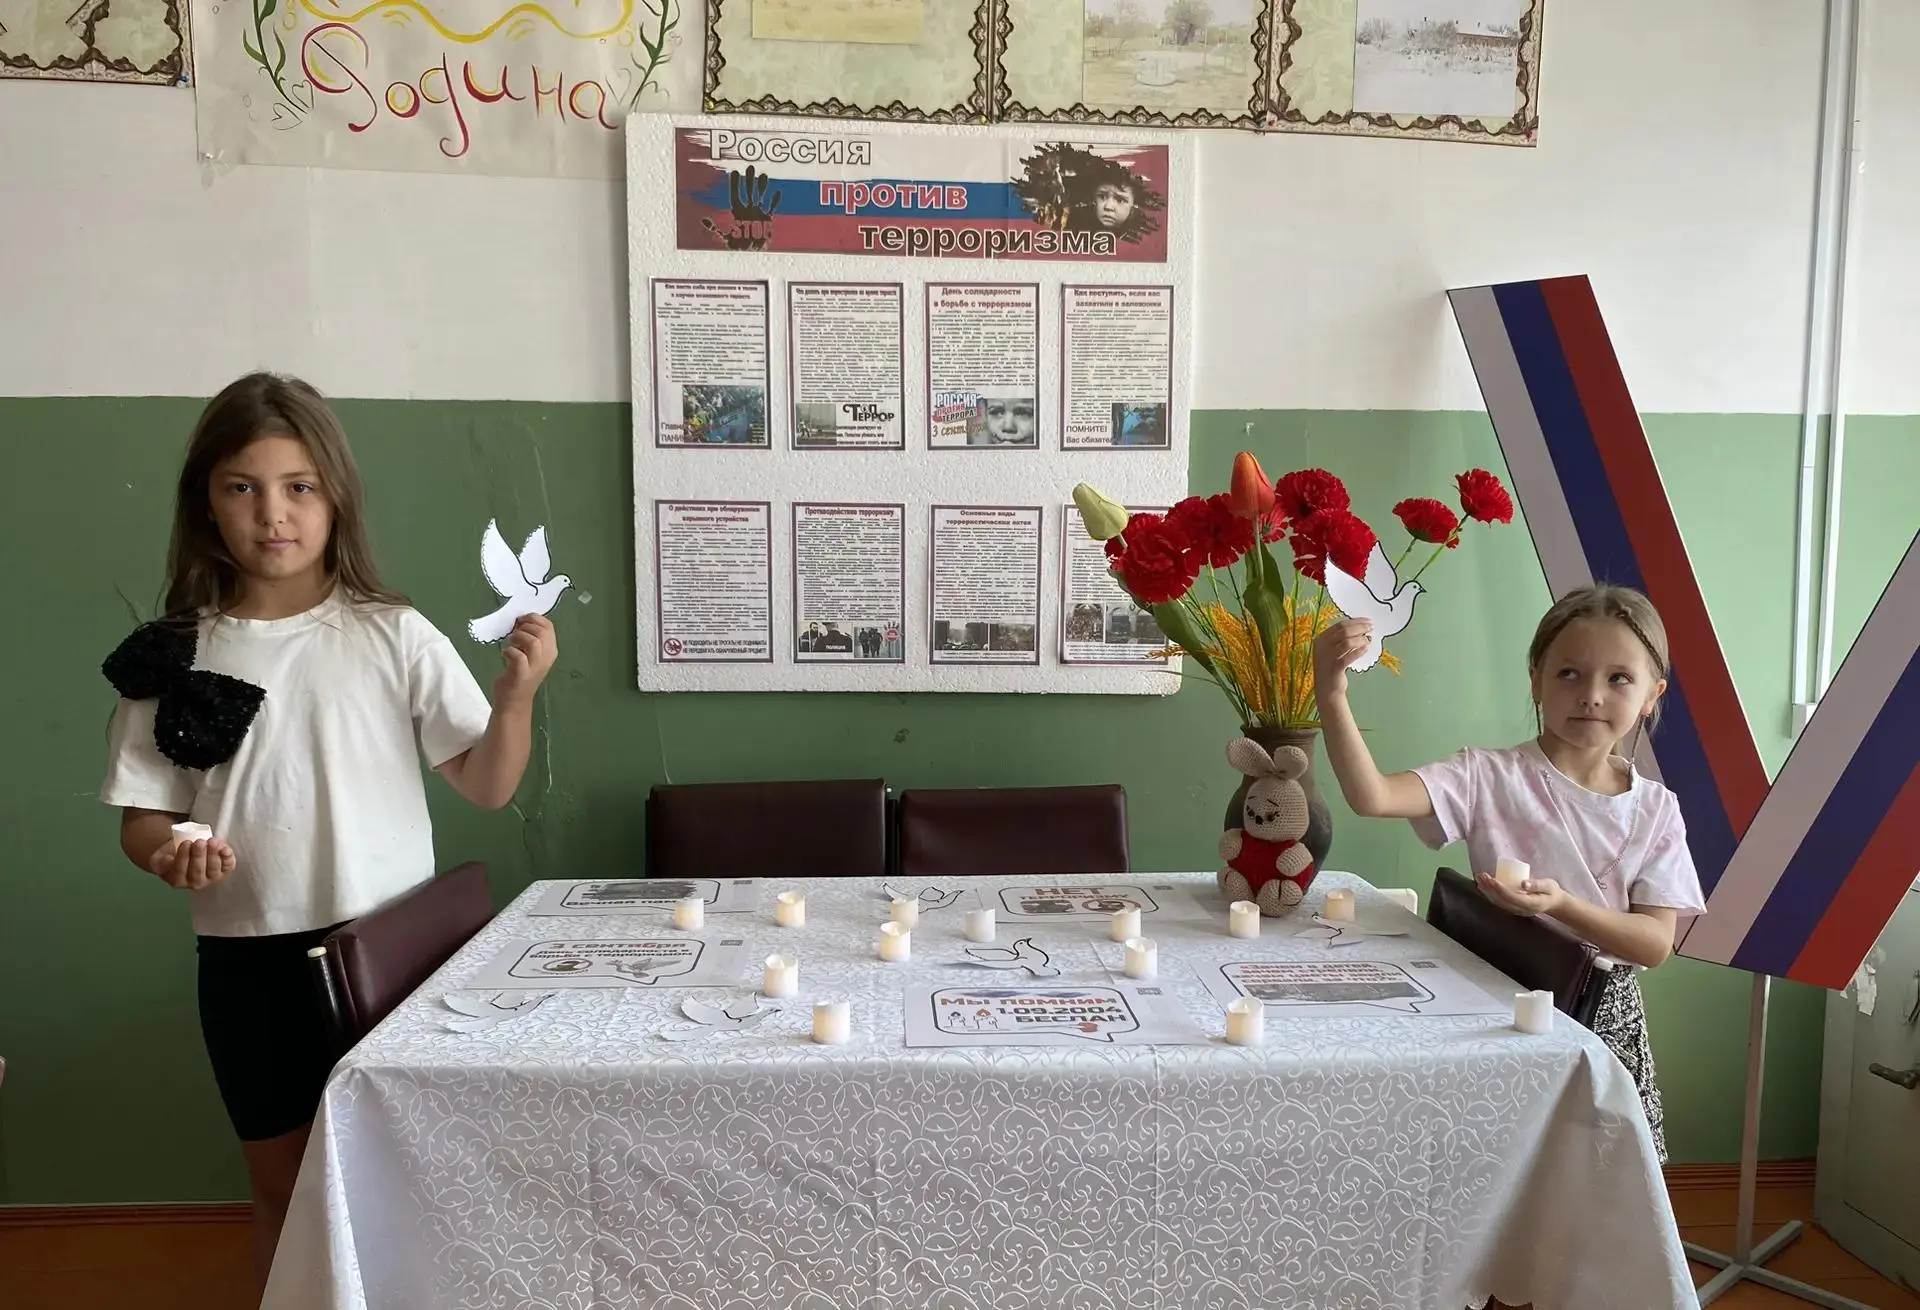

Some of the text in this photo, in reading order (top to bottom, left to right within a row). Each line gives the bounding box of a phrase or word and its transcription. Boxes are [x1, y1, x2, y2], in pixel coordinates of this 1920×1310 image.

[709, 129, 871, 165] Россия
[820, 180, 968, 214] против
[858, 225, 1117, 258] терроризма
[942, 288, 1021, 296] День солидарности
[940, 300, 968, 308] борьбе
[978, 301, 1032, 309] терроризмом
[936, 392, 977, 408] РОССИЯ
[932, 424, 938, 438] 3
[1066, 436, 1080, 444] Вас
[805, 508, 894, 517] Противодействие терроризму
[1034, 887, 1105, 896] НЕТ
[940, 998, 990, 1006] Мы
[1016, 1014, 1126, 1023] БЕСЛАН
